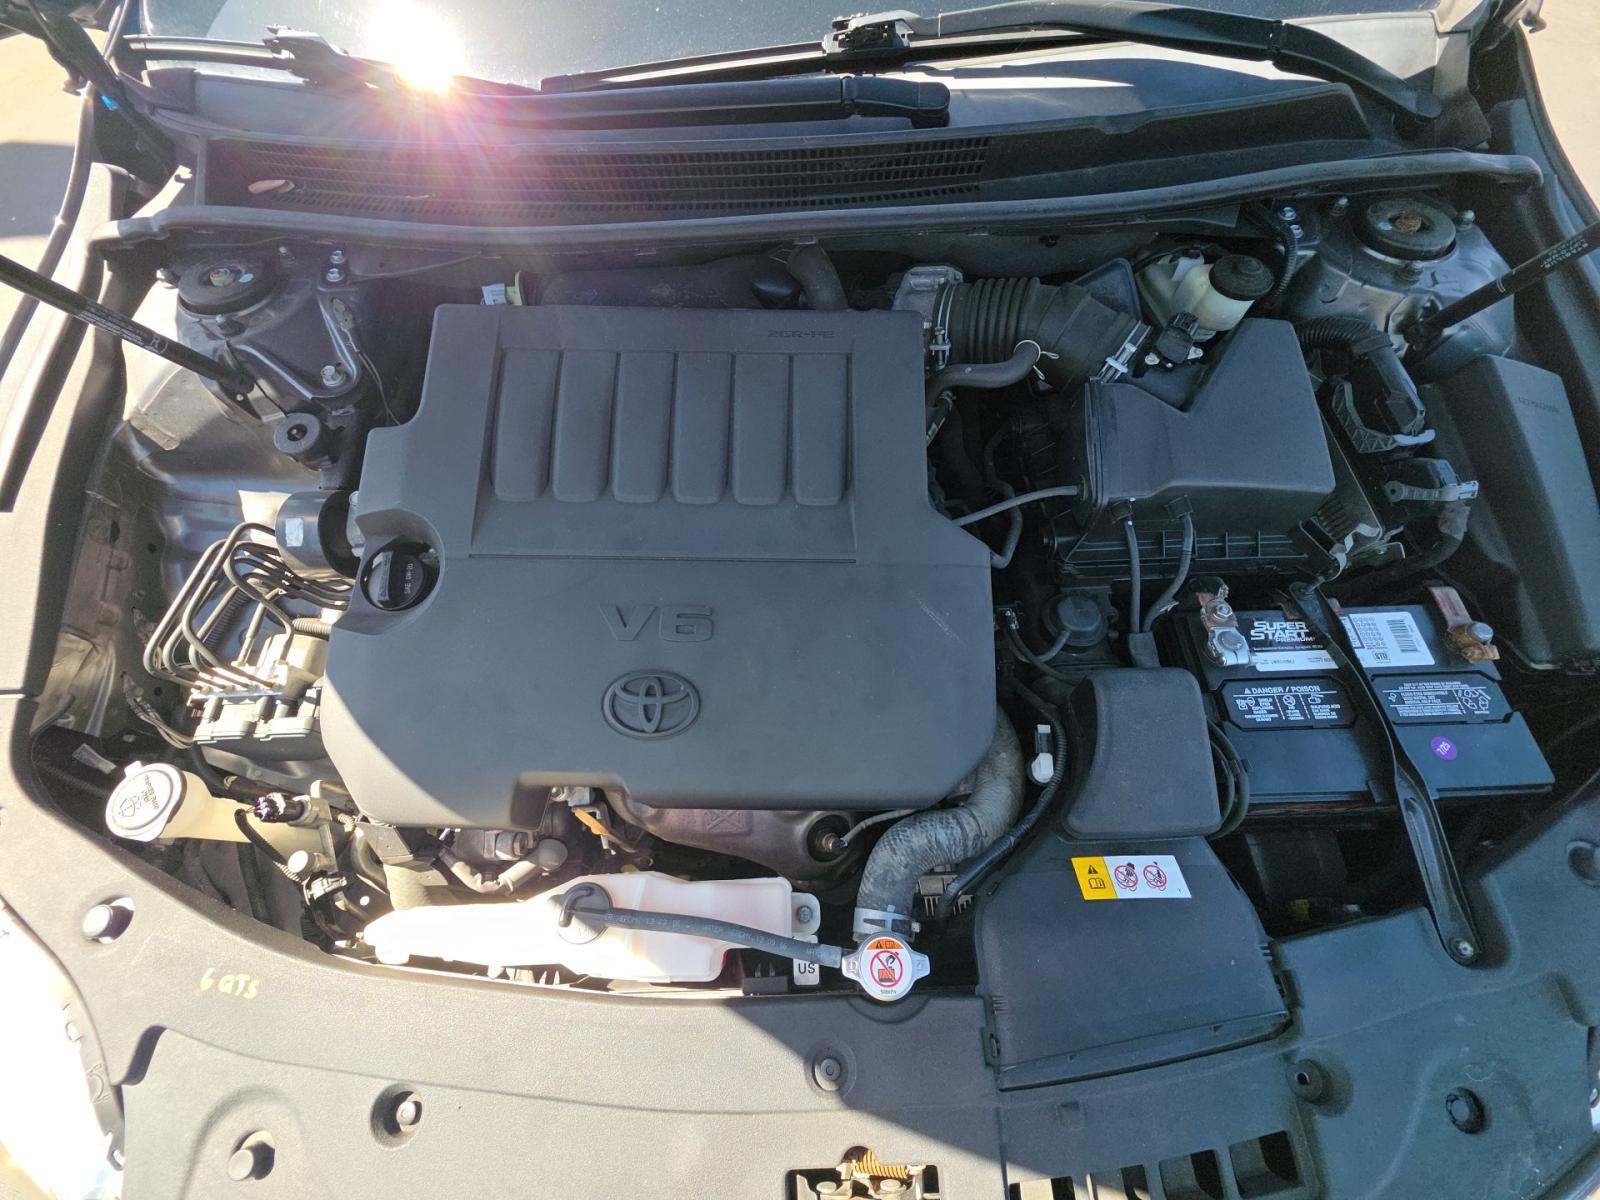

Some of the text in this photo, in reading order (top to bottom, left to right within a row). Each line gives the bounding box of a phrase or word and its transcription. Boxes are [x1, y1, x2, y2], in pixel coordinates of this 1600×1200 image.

[599, 604, 714, 642] V6
[1253, 620, 1306, 631] SUPER
[1250, 629, 1310, 641] START
[1251, 686, 1284, 694] DANGER
[1290, 685, 1321, 693] POISON
[797, 962, 816, 975] US
[200, 967, 216, 992] 6
